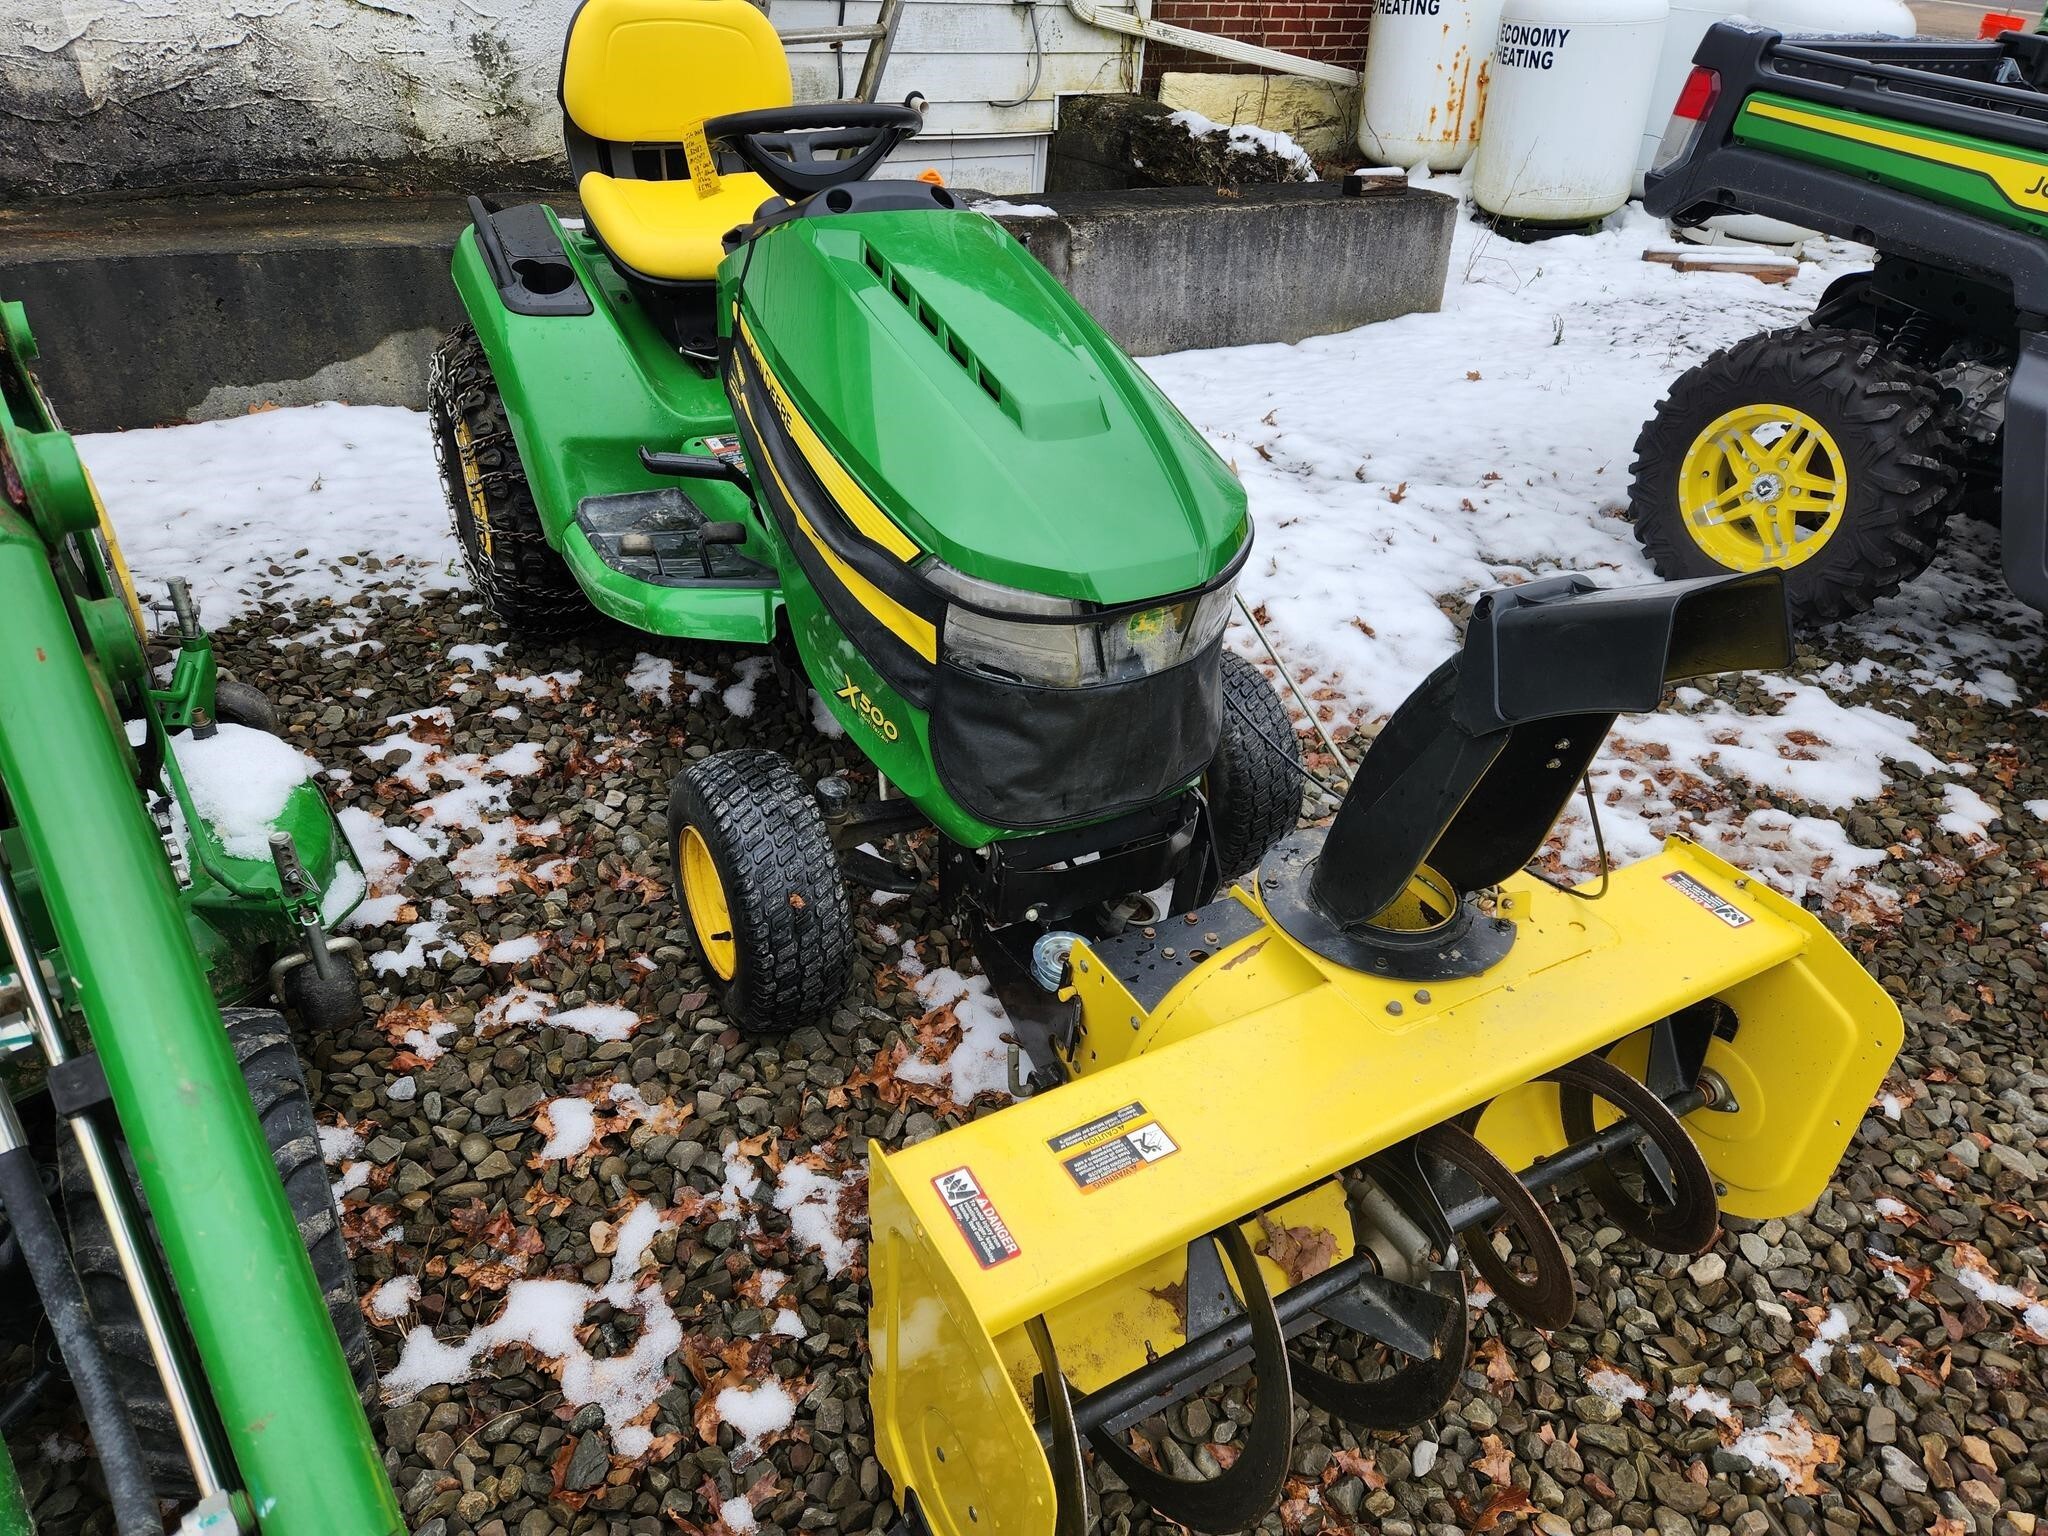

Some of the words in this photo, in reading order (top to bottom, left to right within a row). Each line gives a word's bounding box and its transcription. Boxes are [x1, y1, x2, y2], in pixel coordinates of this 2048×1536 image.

[1378, 0, 1439, 15] HEATING
[1500, 24, 1571, 48] ECONOMY
[1496, 49, 1554, 70] HEATING
[762, 369, 794, 438] DEERE
[836, 673, 898, 740] X500
[1664, 877, 1704, 903] DANGER
[1082, 1127, 1119, 1147] CAUTION
[1091, 1167, 1131, 1190] WARNING
[968, 1198, 977, 1207] To
[972, 1205, 985, 1221] avoid
[962, 1200, 979, 1222] rotating
[984, 1236, 996, 1250] keep
[980, 1219, 994, 1236] injury
[982, 1206, 1018, 1254] DANGER
[967, 1220, 977, 1231] feet
[973, 1230, 983, 1241] and
[979, 1240, 996, 1263] clothing
[990, 1234, 1002, 1248] from
